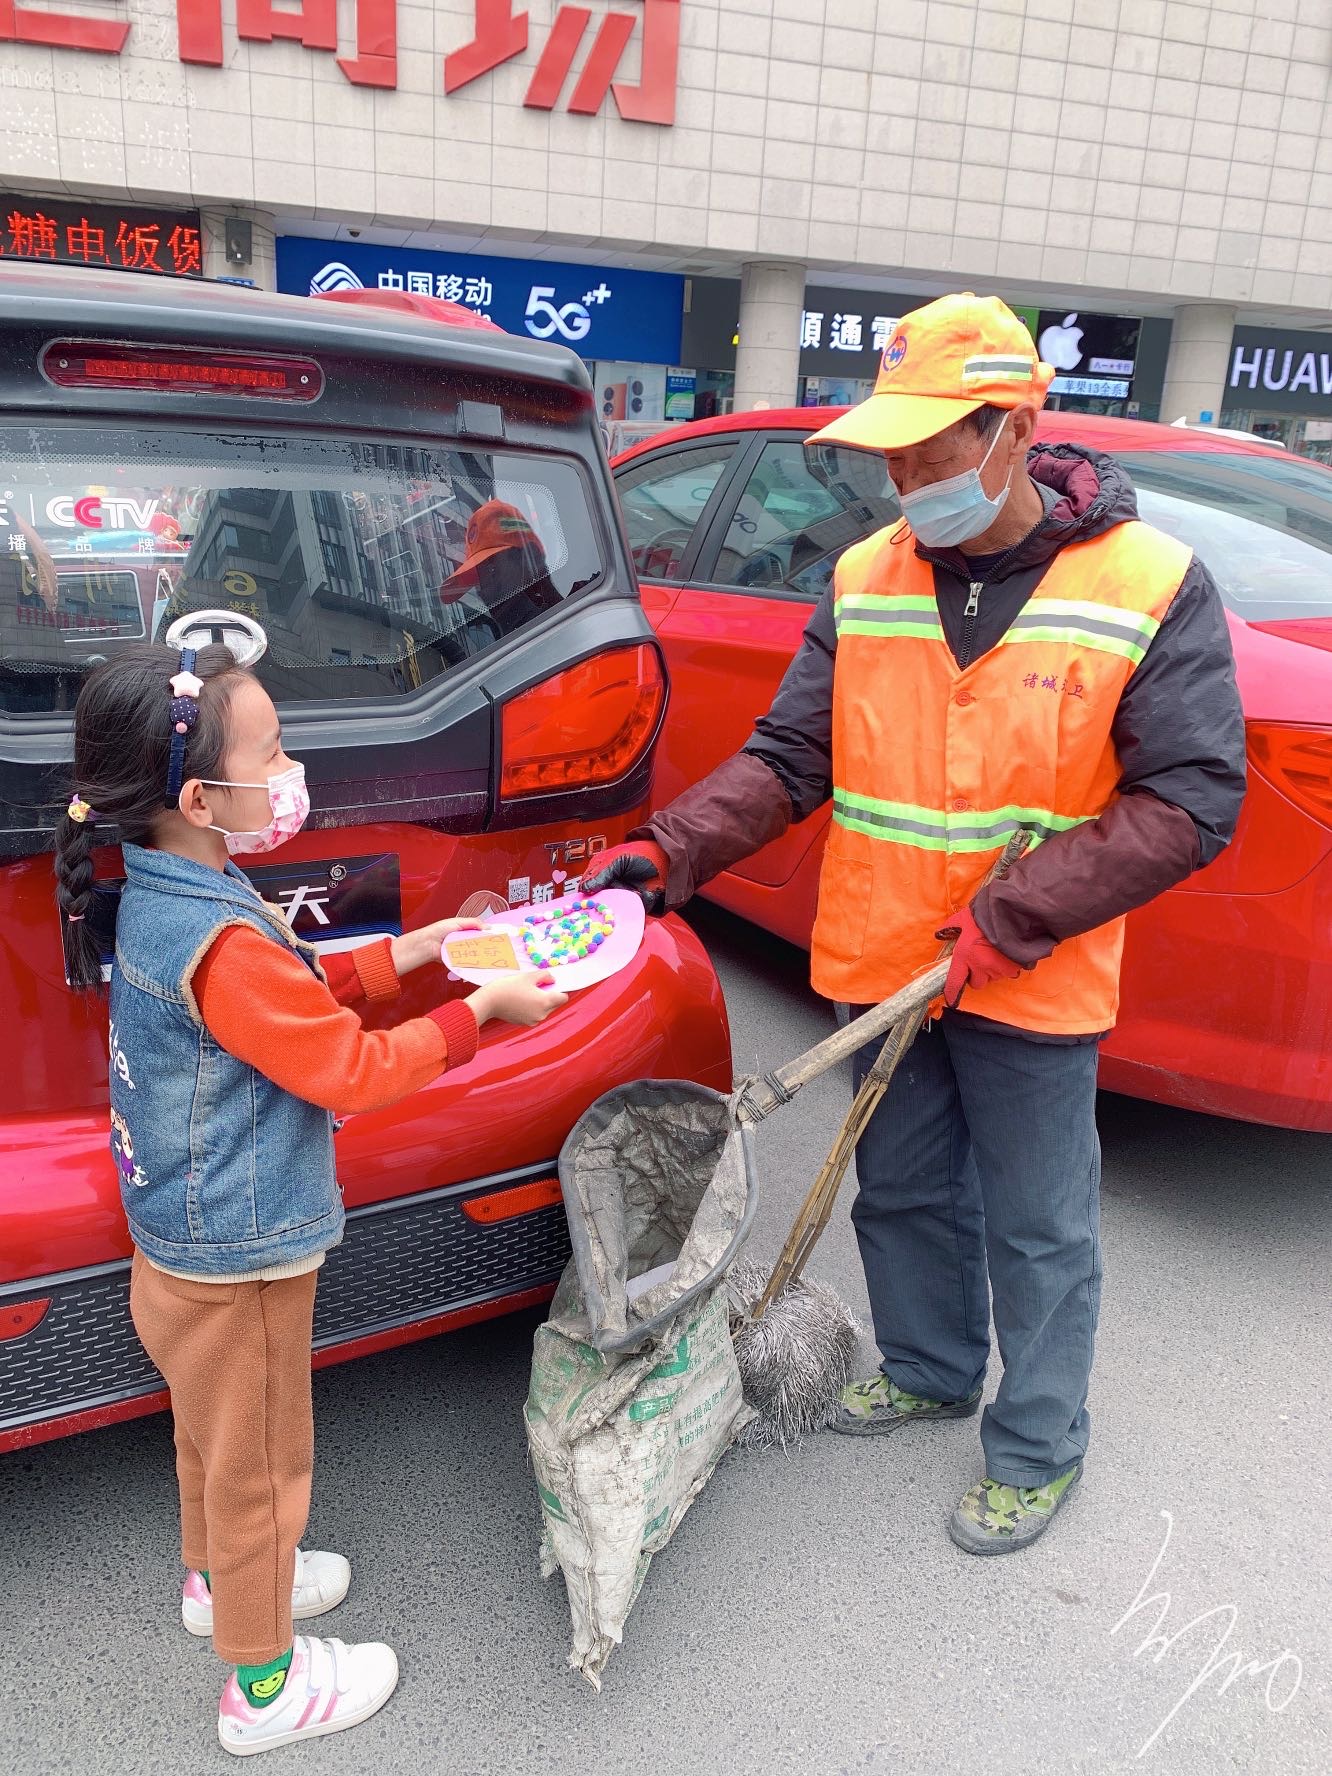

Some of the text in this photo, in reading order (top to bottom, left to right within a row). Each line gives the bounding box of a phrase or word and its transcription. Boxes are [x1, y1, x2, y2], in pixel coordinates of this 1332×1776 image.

[378, 268, 492, 306] 中国移动
[46, 495, 159, 529] CCTV
[544, 834, 608, 865] T20
